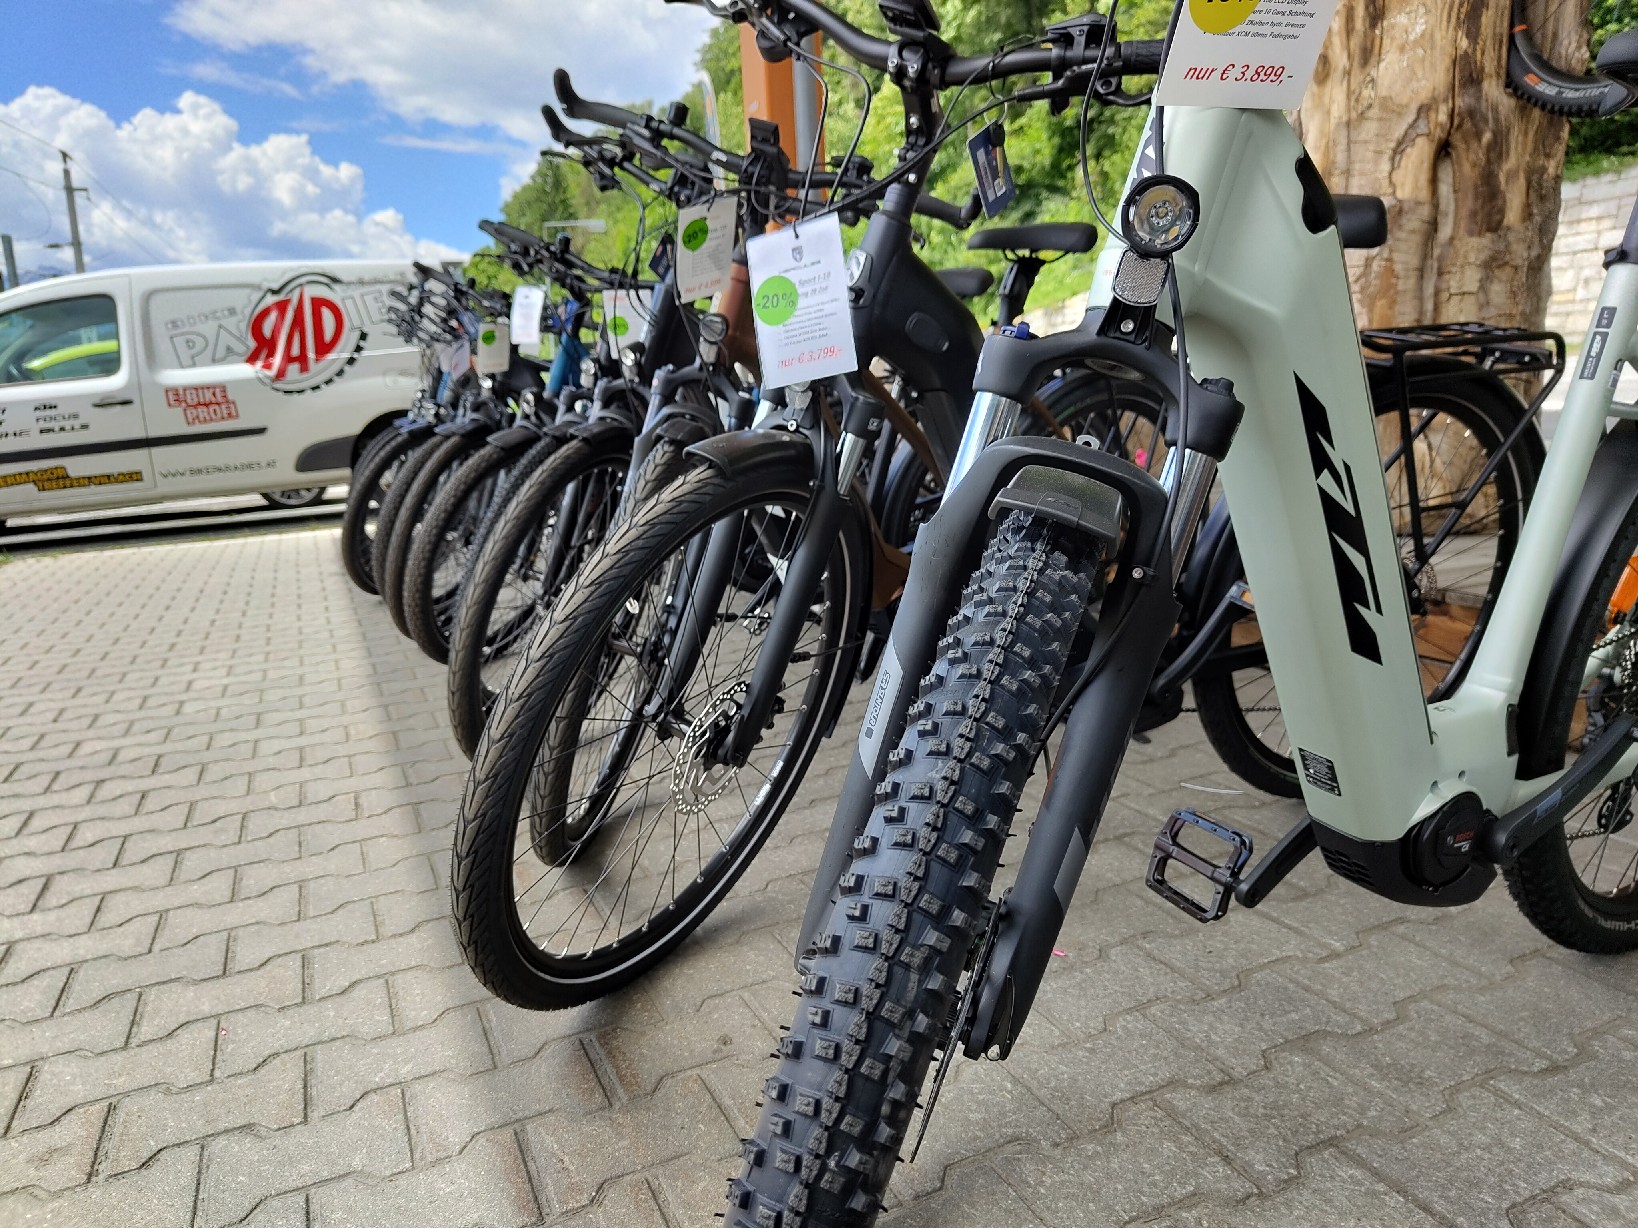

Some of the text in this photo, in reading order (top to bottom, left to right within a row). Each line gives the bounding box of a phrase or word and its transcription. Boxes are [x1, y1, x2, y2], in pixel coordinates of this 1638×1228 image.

[1287, 9, 1316, 19] Schaltung
[1184, 63, 1294, 87] nur € 3.899,-
[166, 386, 228, 408] E-BIKE
[184, 401, 238, 425] PROFI
